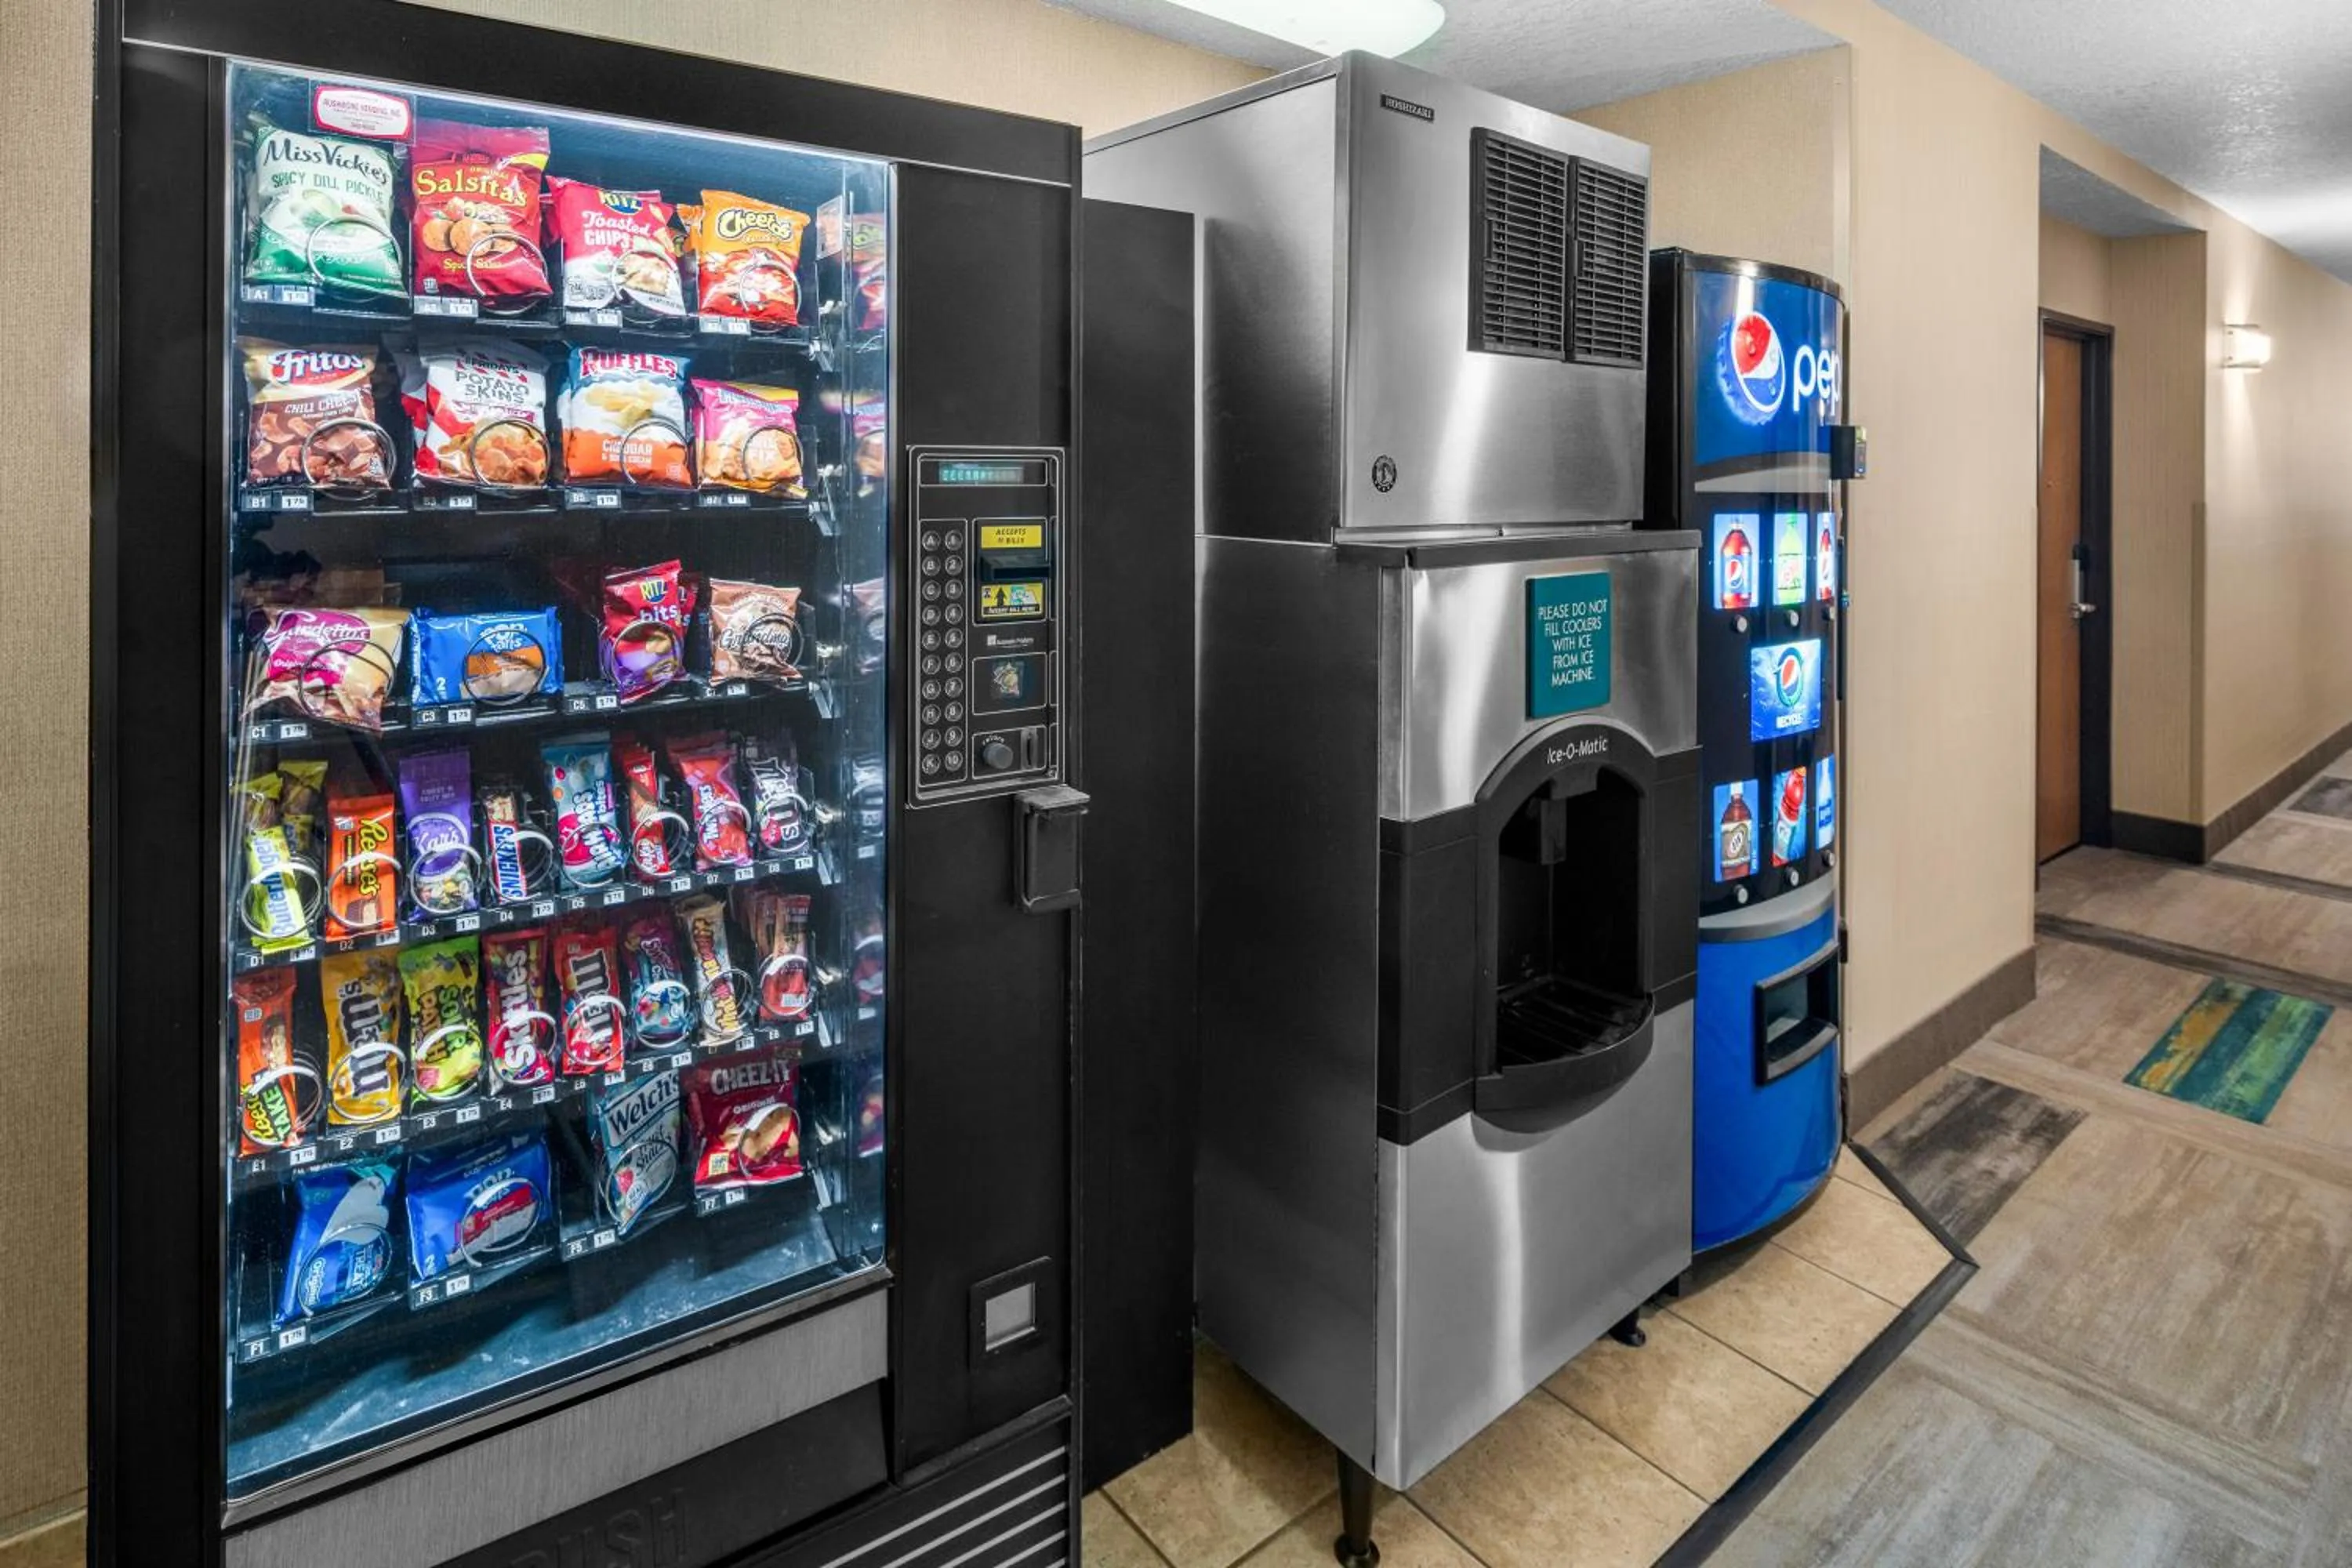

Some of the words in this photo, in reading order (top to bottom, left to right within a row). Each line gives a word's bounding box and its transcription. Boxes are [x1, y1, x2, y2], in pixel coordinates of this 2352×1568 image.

[263, 139, 321, 167] Miss
[317, 140, 390, 185] Vickie's
[270, 172, 306, 189] SPICY
[416, 169, 528, 208] Salsitas
[581, 209, 652, 234] Toasted
[718, 208, 793, 240] Cheetos
[583, 228, 634, 249] CHIPS
[267, 349, 364, 382] Fritos
[580, 346, 677, 379] RUFFLES
[455, 372, 530, 396] POTATO
[465, 384, 524, 404] SKINS
[284, 402, 314, 414] CHILI
[252, 497, 267, 508] B1
[639, 579, 667, 600] RITZ
[639, 604, 678, 625] bits
[1537, 604, 1570, 620] PLEASE
[1572, 601, 1586, 616] DO
[1588, 599, 1608, 615] NOT
[1544, 622, 1560, 637] FILL
[1562, 616, 1602, 634] COOLERS
[1552, 637, 1576, 652] WITH
[1578, 634, 1592, 648] ICE
[1552, 653, 1578, 670] FROM
[1581, 650, 1594, 665] ICE
[436, 677, 446, 691] 2
[1552, 666, 1596, 687] MACHINE.
[573, 699, 586, 710] C5
[423, 712, 436, 722] C3
[252, 728, 266, 738] C1
[1546, 735, 1609, 765] Ice-O-Matic
[572, 790, 618, 869] AIRHADS
[359, 817, 390, 896] Rese's
[494, 825, 524, 902] SNICKERS
[707, 874, 719, 884] D7
[642, 887, 655, 895] D6
[499, 911, 514, 921] D4
[422, 926, 436, 935] D3
[339, 941, 354, 951] D2
[250, 956, 264, 967] D1
[439, 985, 467, 1050] SOUR
[499, 949, 537, 1069] Skittles
[419, 989, 448, 1064] PATH
[262, 1084, 291, 1140] TAKE
[499, 1099, 513, 1110] E4
[609, 1073, 680, 1137] Welch's
[339, 1138, 354, 1149] E2
[252, 1160, 266, 1171] E1
[418, 1288, 434, 1301] F3
[250, 1341, 264, 1356] F1
